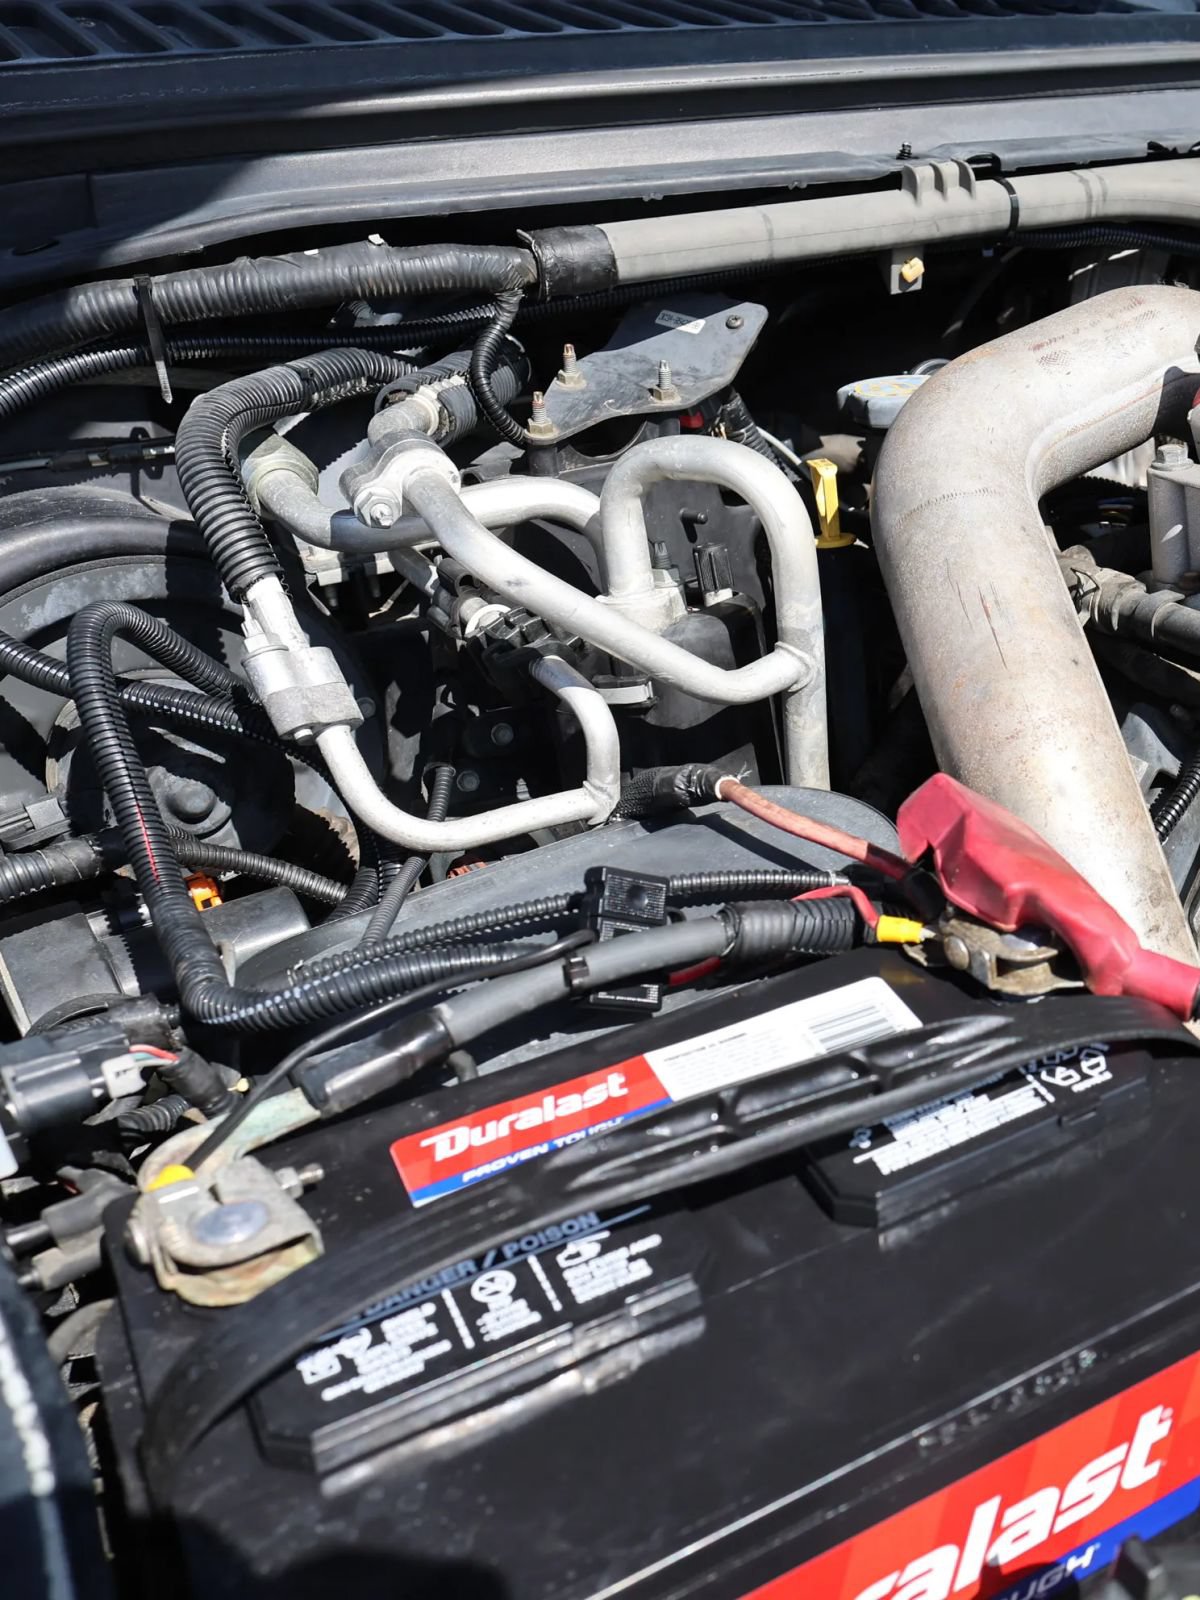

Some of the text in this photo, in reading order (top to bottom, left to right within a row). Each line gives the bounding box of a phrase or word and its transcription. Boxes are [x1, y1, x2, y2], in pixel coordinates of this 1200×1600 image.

[420, 1071, 628, 1162] Duralast
[461, 1142, 550, 1183] PROVEN
[502, 1211, 600, 1260] POISON
